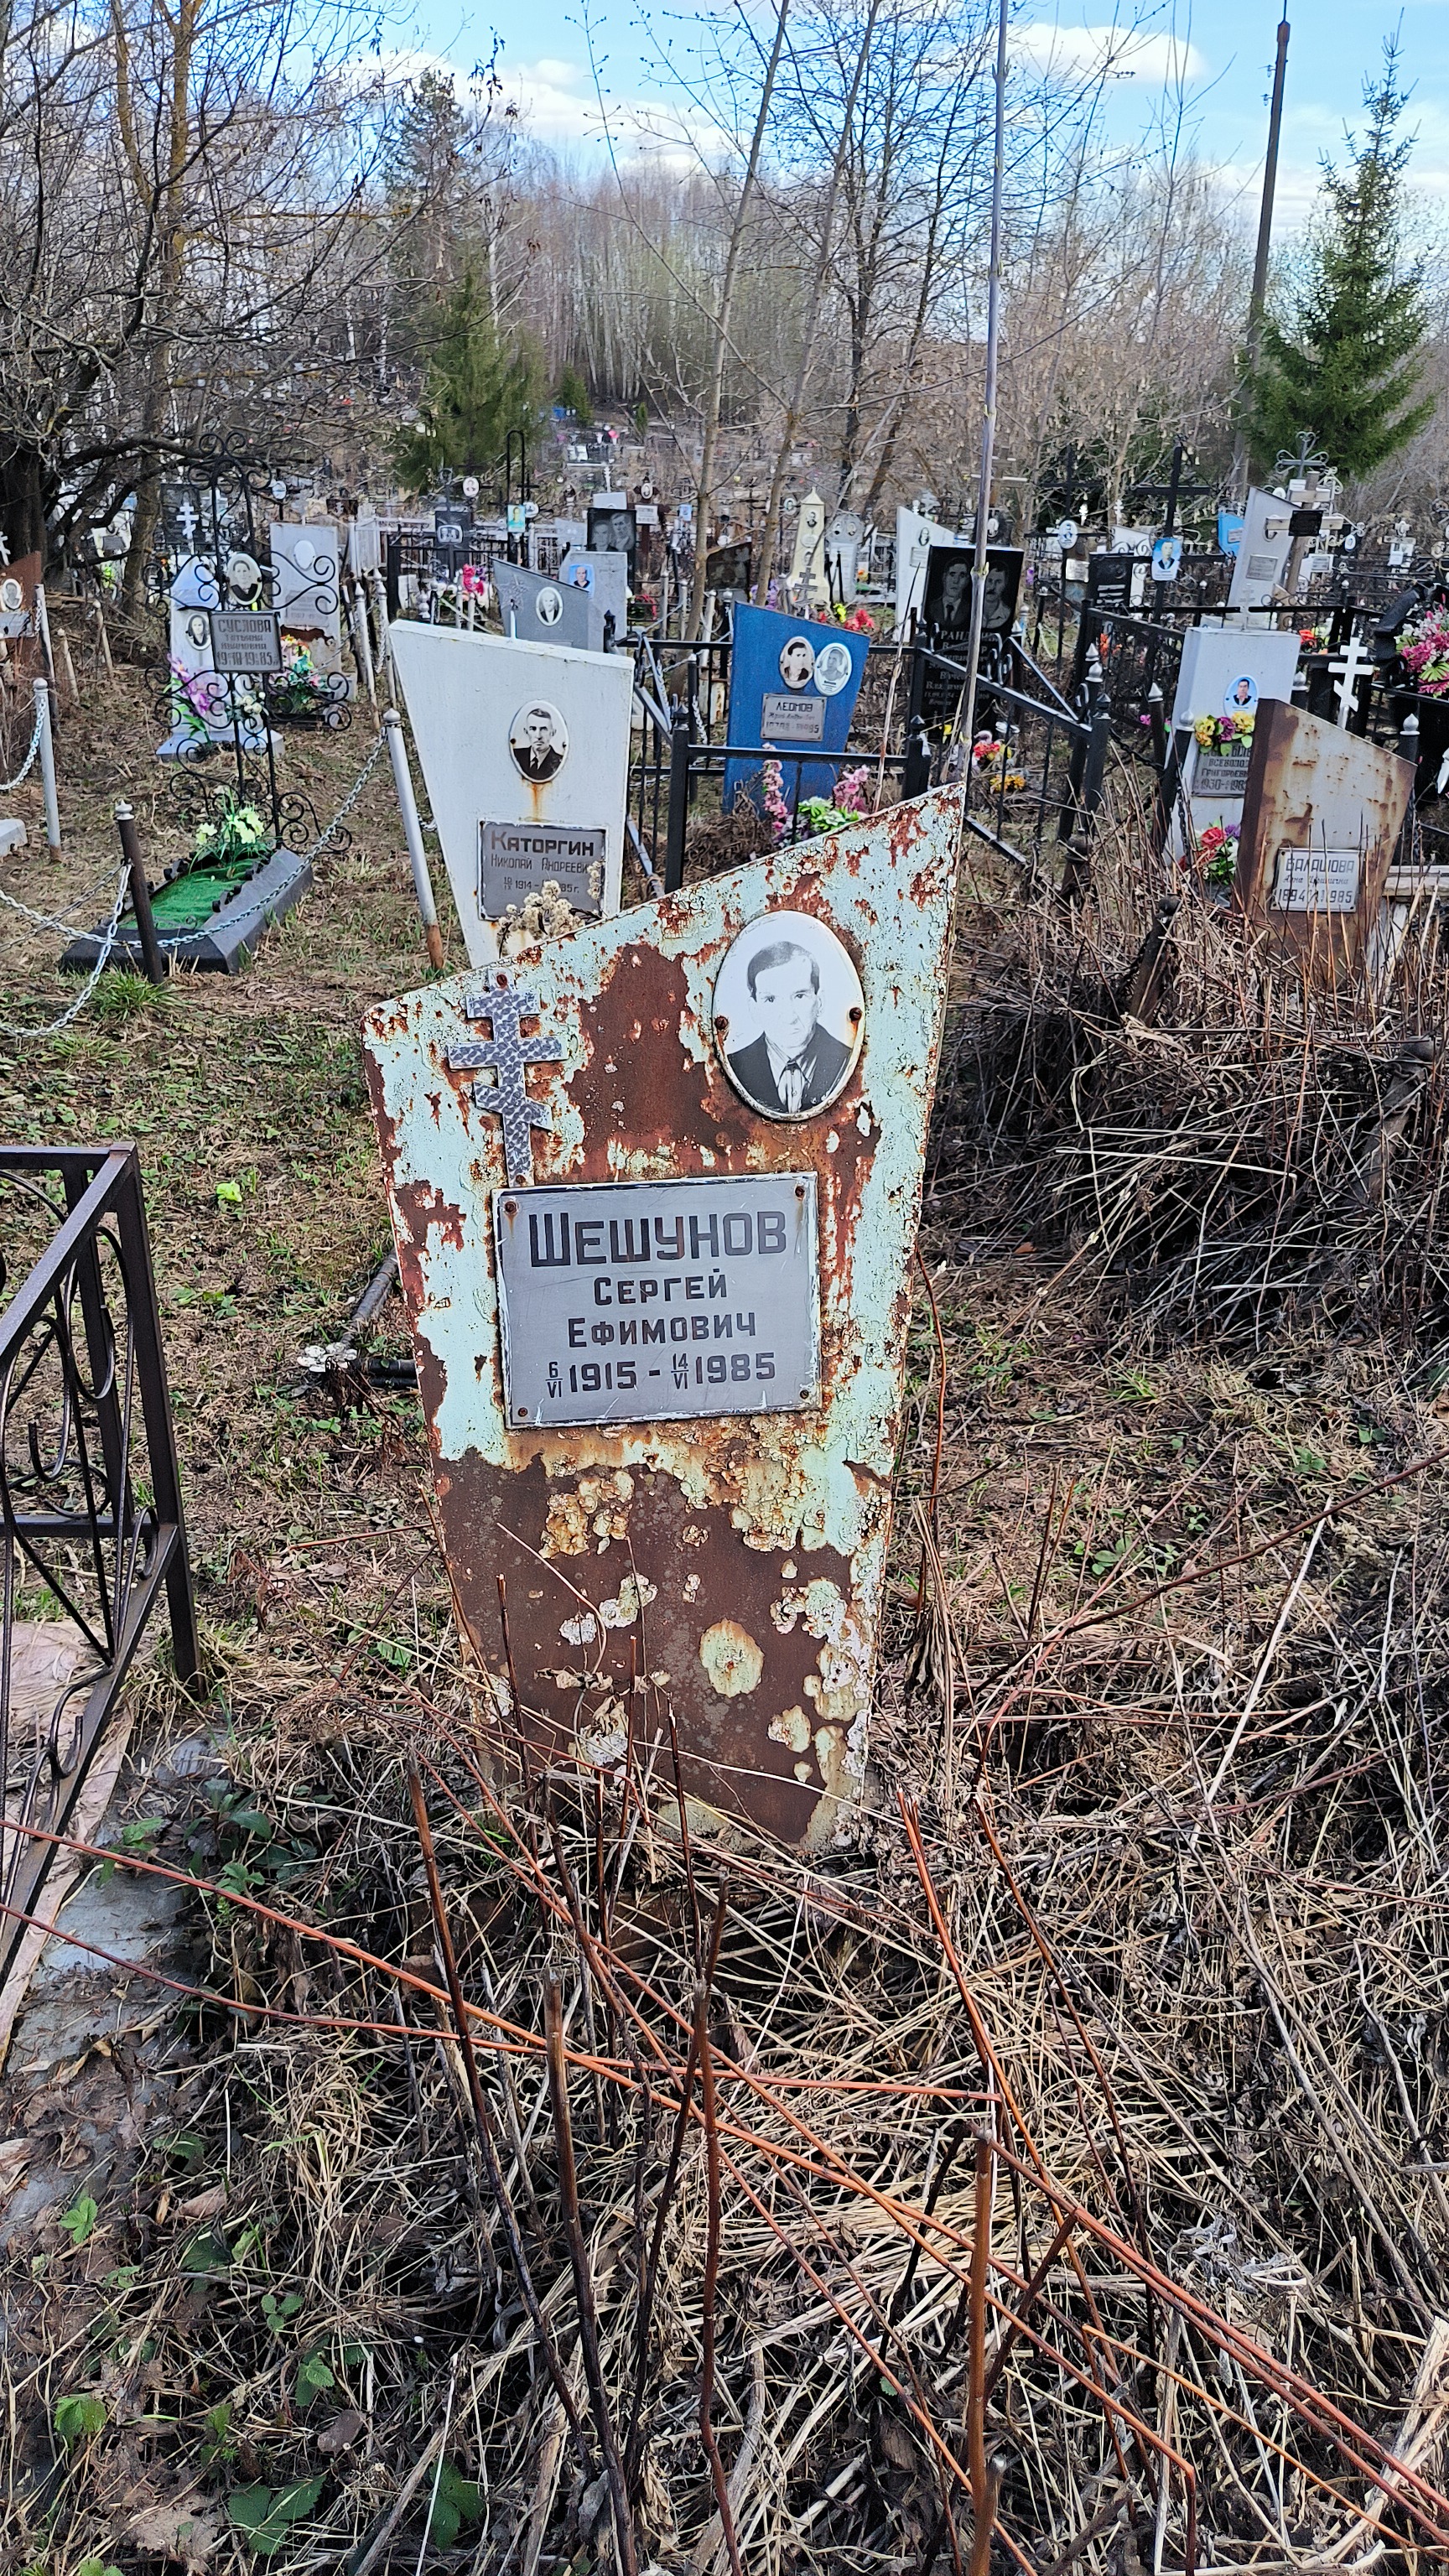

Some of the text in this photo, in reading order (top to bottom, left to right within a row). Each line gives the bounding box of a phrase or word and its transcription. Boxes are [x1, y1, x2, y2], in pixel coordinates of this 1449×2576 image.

[218, 619, 272, 632] СУСЛОВА
[491, 830, 595, 856] КАТОРГИН
[491, 854, 589, 874] НИКОЛАЙ АНДРЕЕВИ
[528, 1210, 787, 1268] ШЕШУНОВ
[594, 1268, 728, 1306] СЕРГЕЙ
[568, 1311, 756, 1348] ЕФИМОВИЧ
[569, 1360, 636, 1394] 1915
[694, 1351, 776, 1384] 1985
